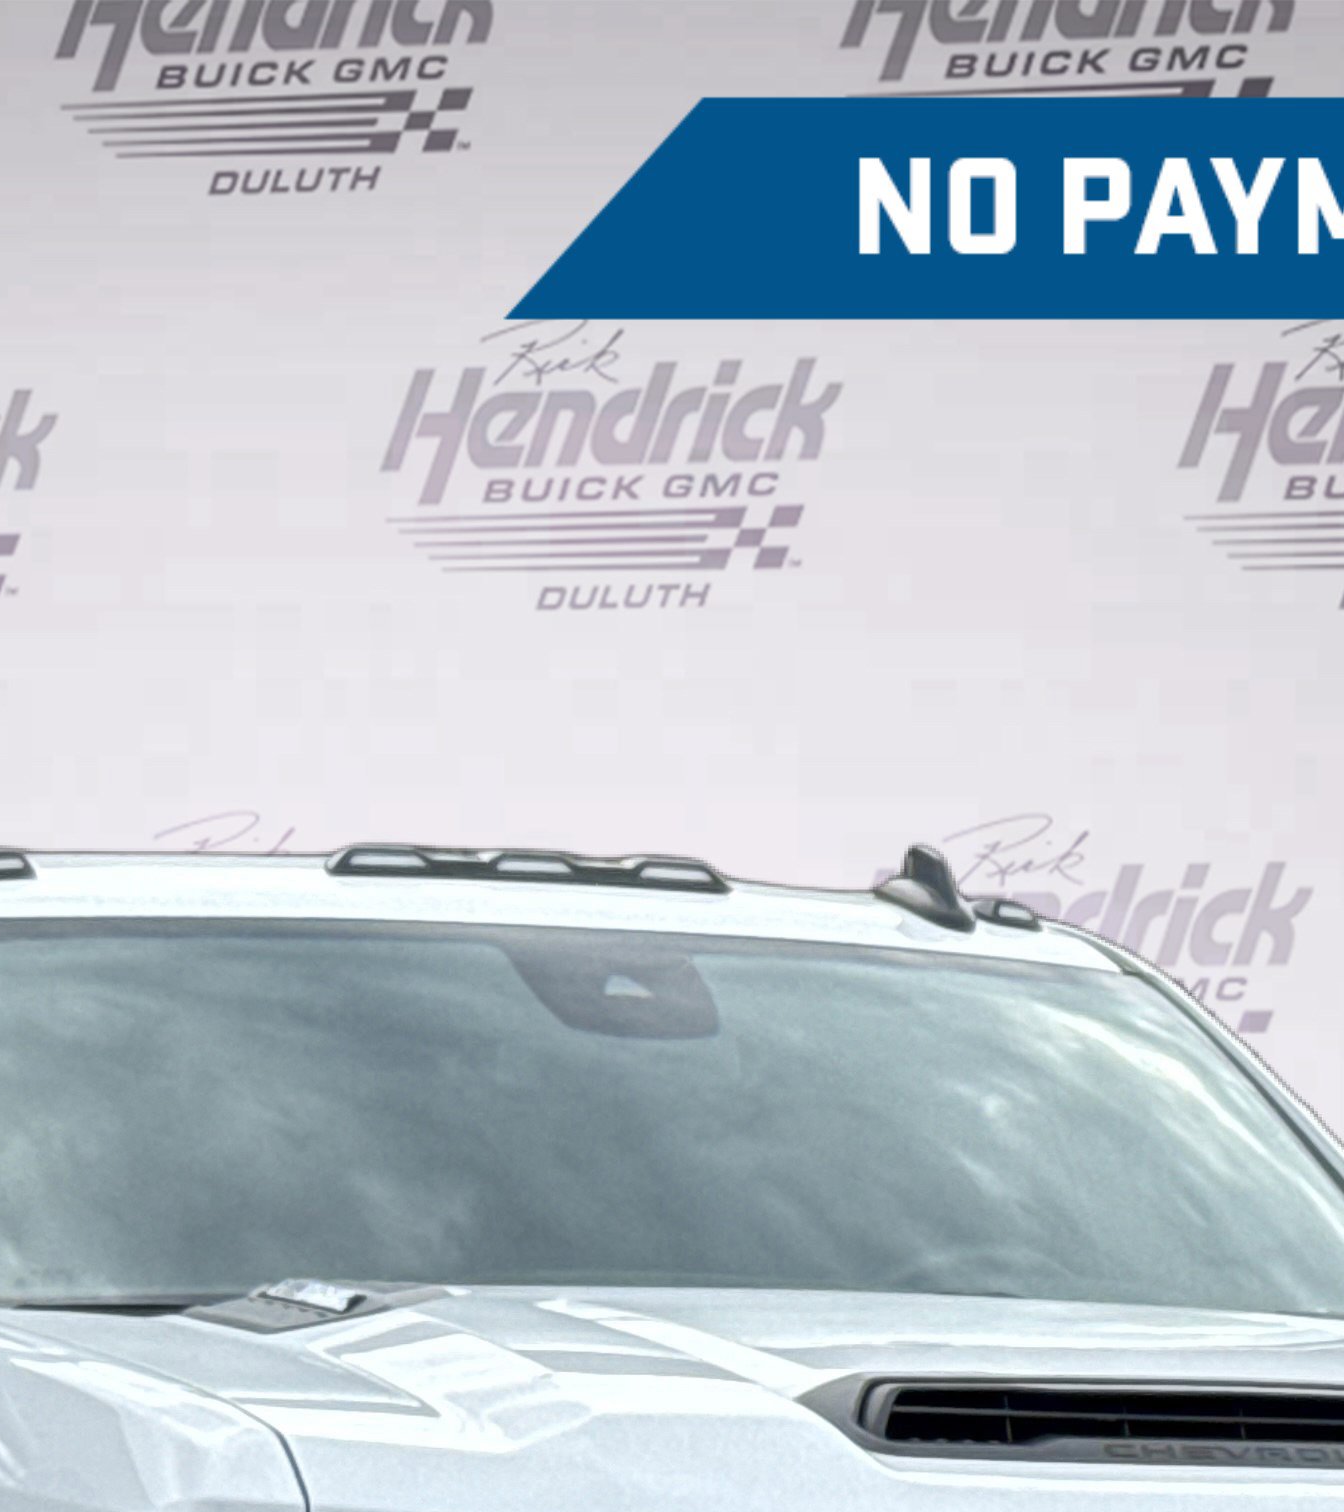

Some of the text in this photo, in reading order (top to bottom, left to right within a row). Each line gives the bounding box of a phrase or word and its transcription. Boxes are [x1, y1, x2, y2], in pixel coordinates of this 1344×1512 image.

[156, 55, 449, 90] BUICK GMC
[944, 44, 1249, 79] BUICK GMC
[208, 166, 382, 195] DULUTH
[379, 357, 844, 506] Hendrick
[481, 471, 780, 504] BUICK GMC
[535, 583, 711, 612] DULUTH
[942, 813, 1090, 887] Rick
